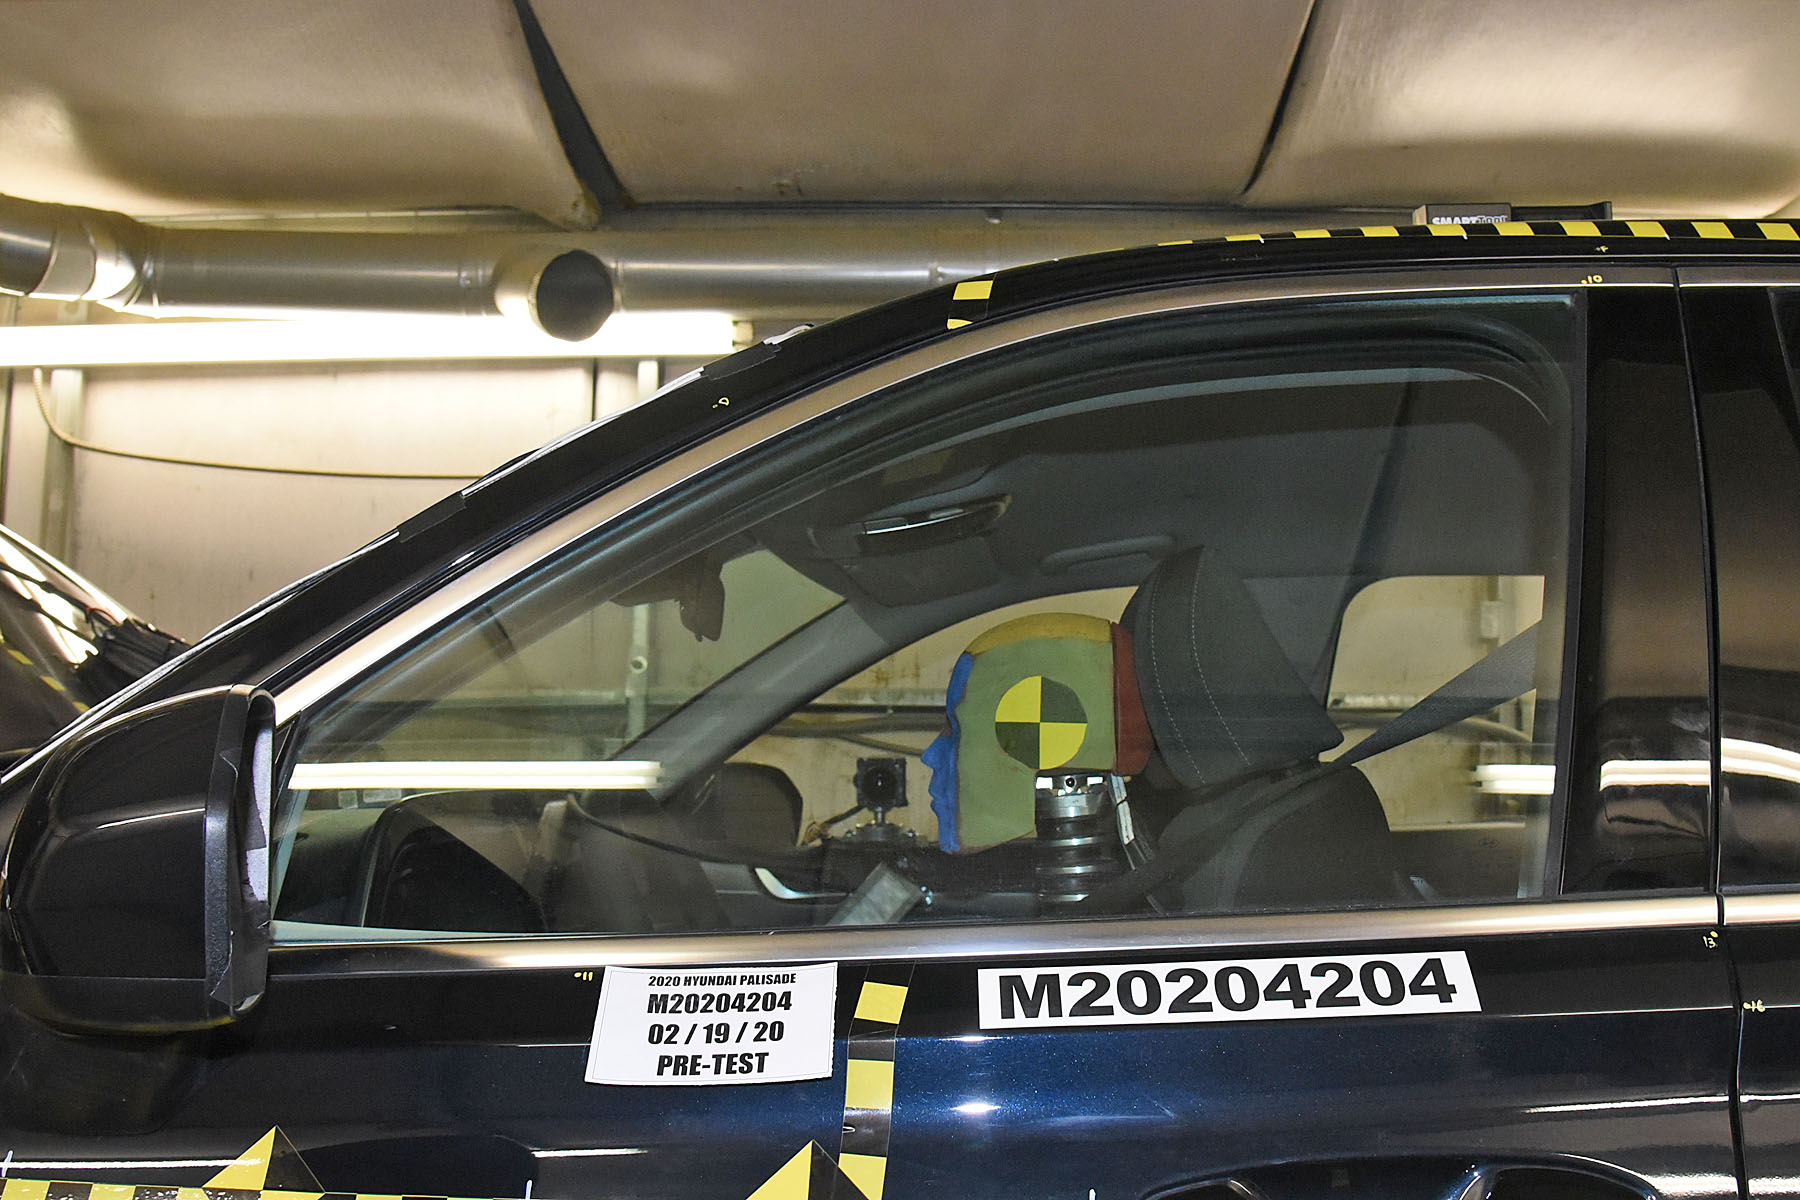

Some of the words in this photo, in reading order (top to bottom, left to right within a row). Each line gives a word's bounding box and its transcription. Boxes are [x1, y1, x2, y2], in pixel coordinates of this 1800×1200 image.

[648, 976, 681, 987] 2020
[683, 975, 737, 987] HYUNDAI
[739, 973, 796, 985] PALISADE
[1000, 958, 1457, 1019] M20204204
[647, 991, 792, 1014] M20204204
[656, 1052, 769, 1076] PRE-TEST
